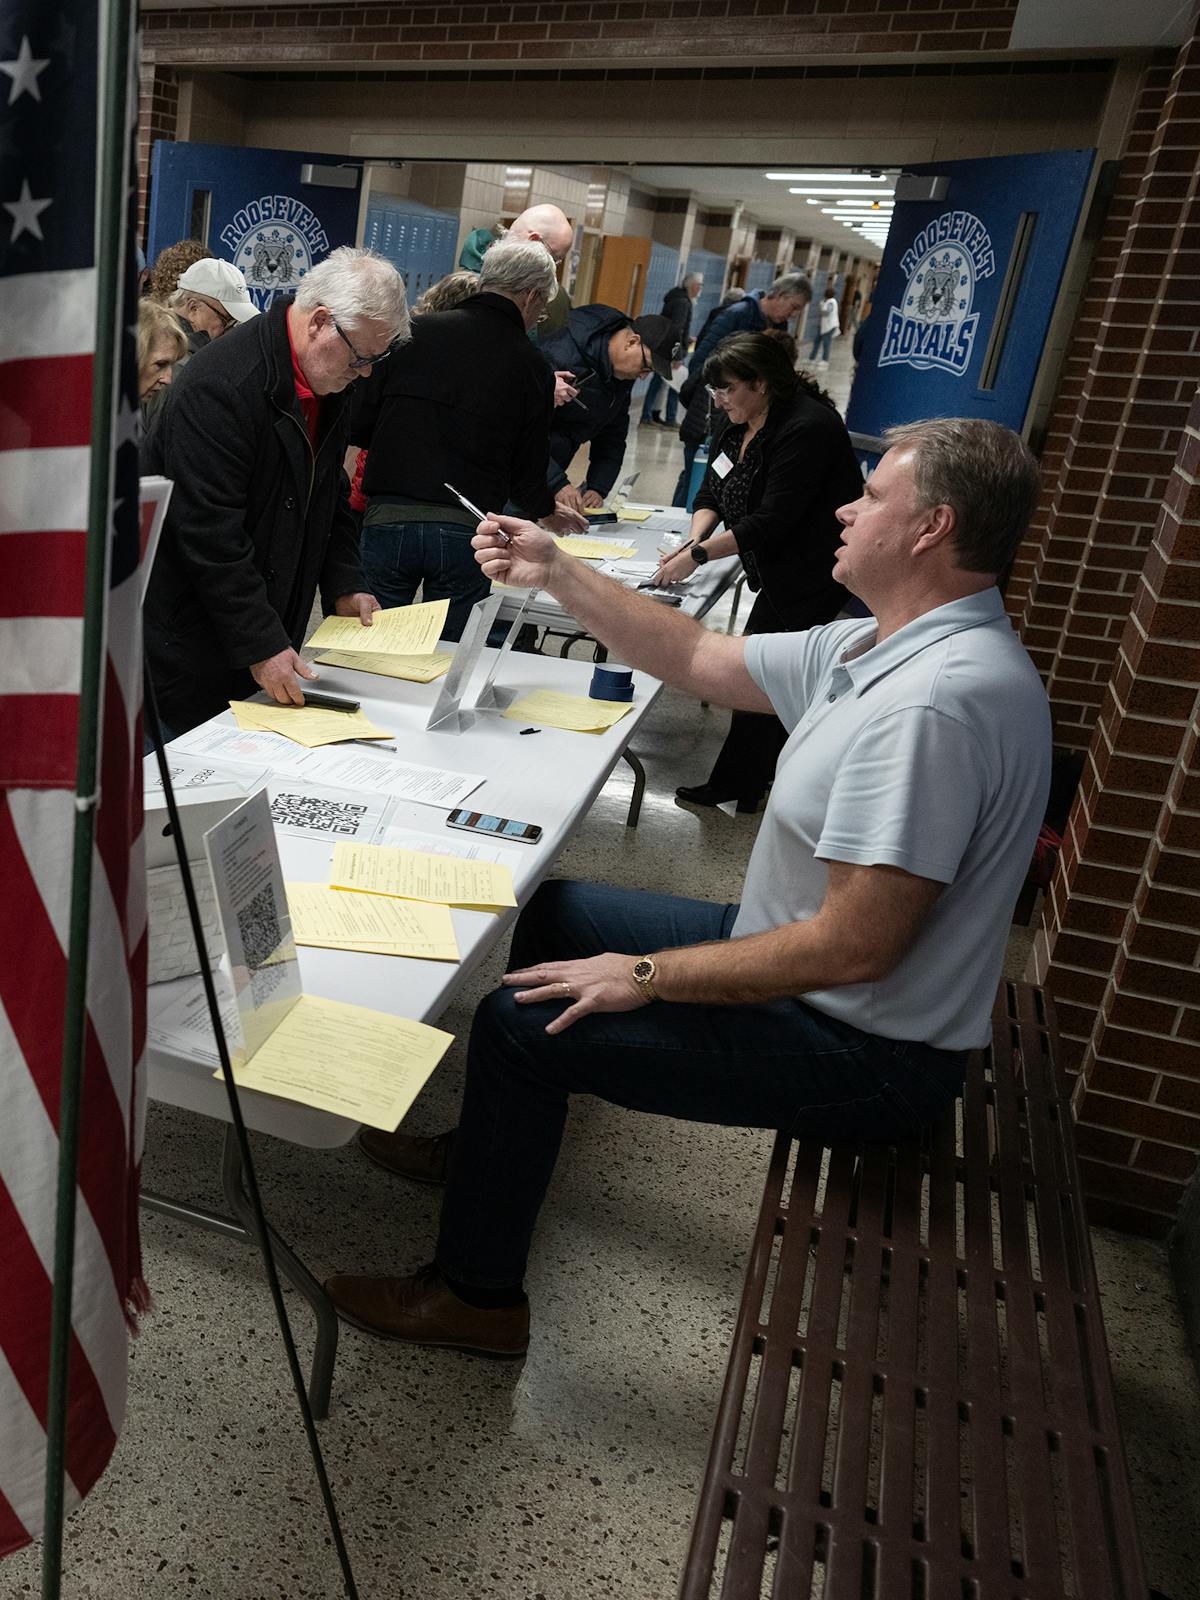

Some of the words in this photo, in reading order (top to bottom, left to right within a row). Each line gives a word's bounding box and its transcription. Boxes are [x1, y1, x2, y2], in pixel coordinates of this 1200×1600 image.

[220, 195, 329, 255] ROOSEVELT
[900, 211, 995, 281] ROOSEVELT
[882, 310, 977, 368] ROYALS
